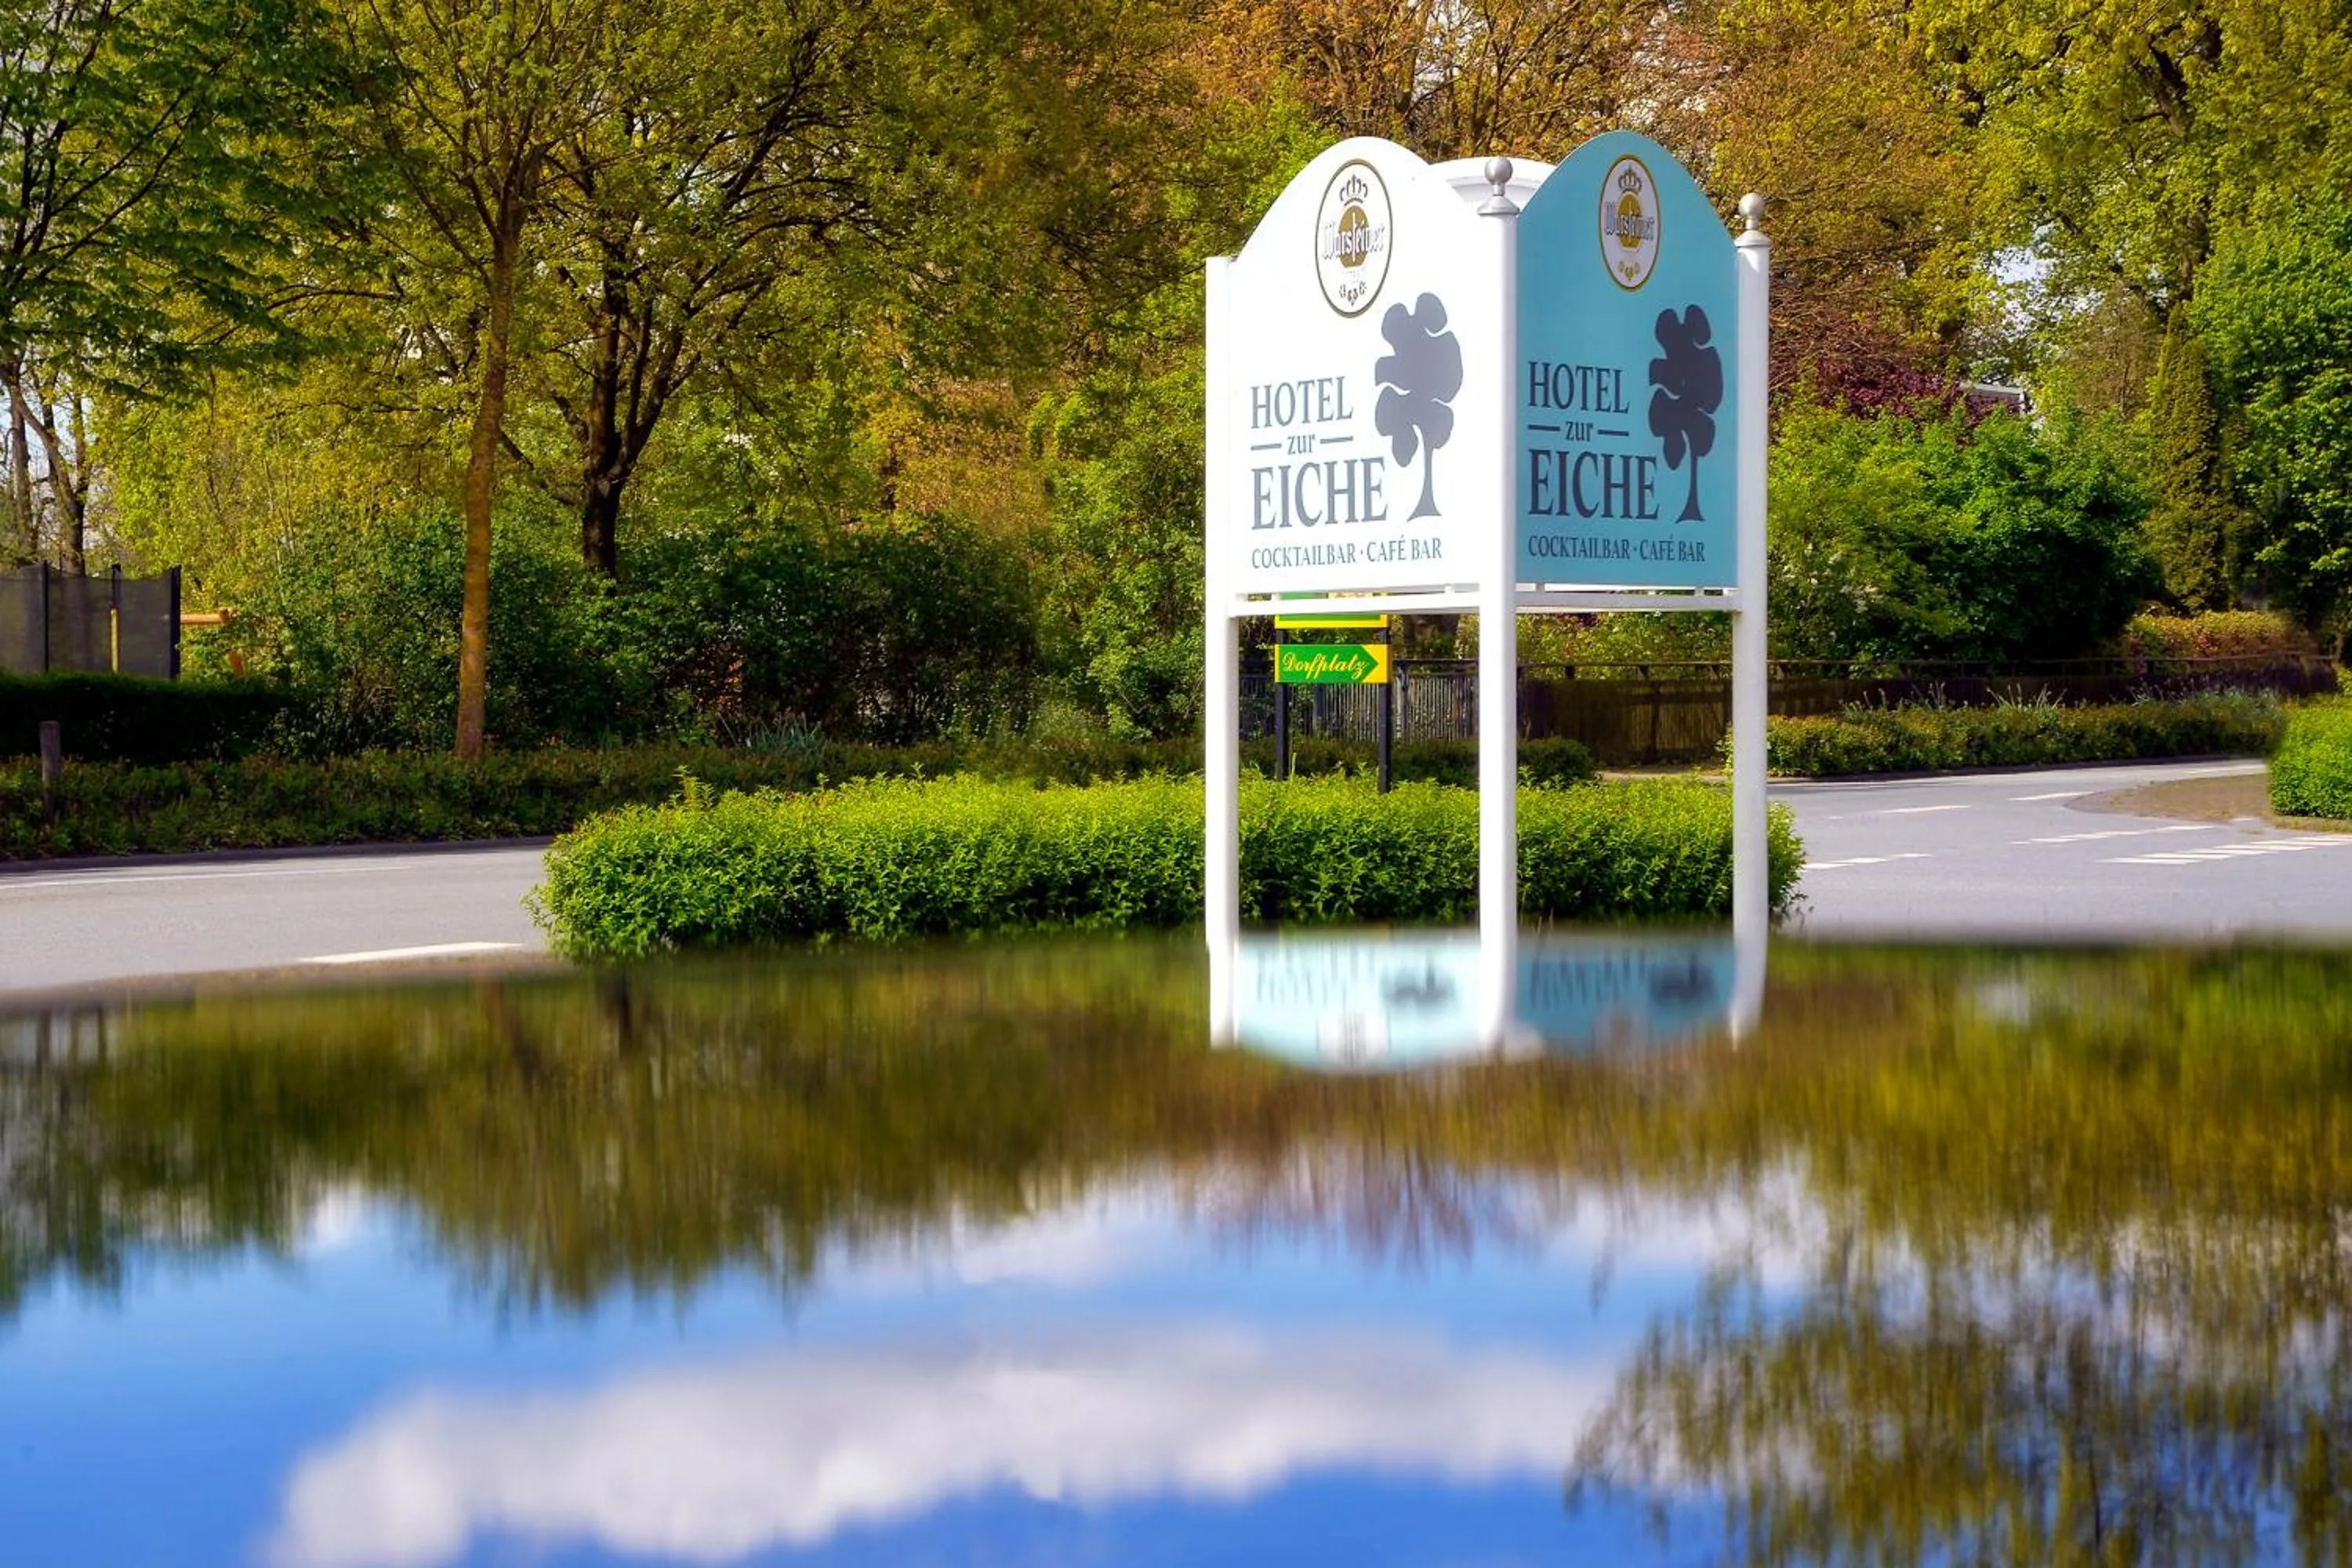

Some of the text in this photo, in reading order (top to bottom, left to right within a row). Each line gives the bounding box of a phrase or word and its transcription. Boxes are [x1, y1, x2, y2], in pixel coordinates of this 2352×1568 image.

[1250, 376, 1354, 429] HOTEL
[1528, 361, 1630, 415] HOTEL
[1287, 434, 1316, 455] zur
[1566, 421, 1594, 442] zur
[1250, 456, 1388, 530] EICHE
[1528, 448, 1660, 521] EICHE
[1251, 534, 1443, 568] COCKTAILBAR CAFÉ BAR
[1528, 533, 1705, 562] COCKTAILBAR CAFÉ BAR
[1282, 652, 1367, 680] Dorfplatz
